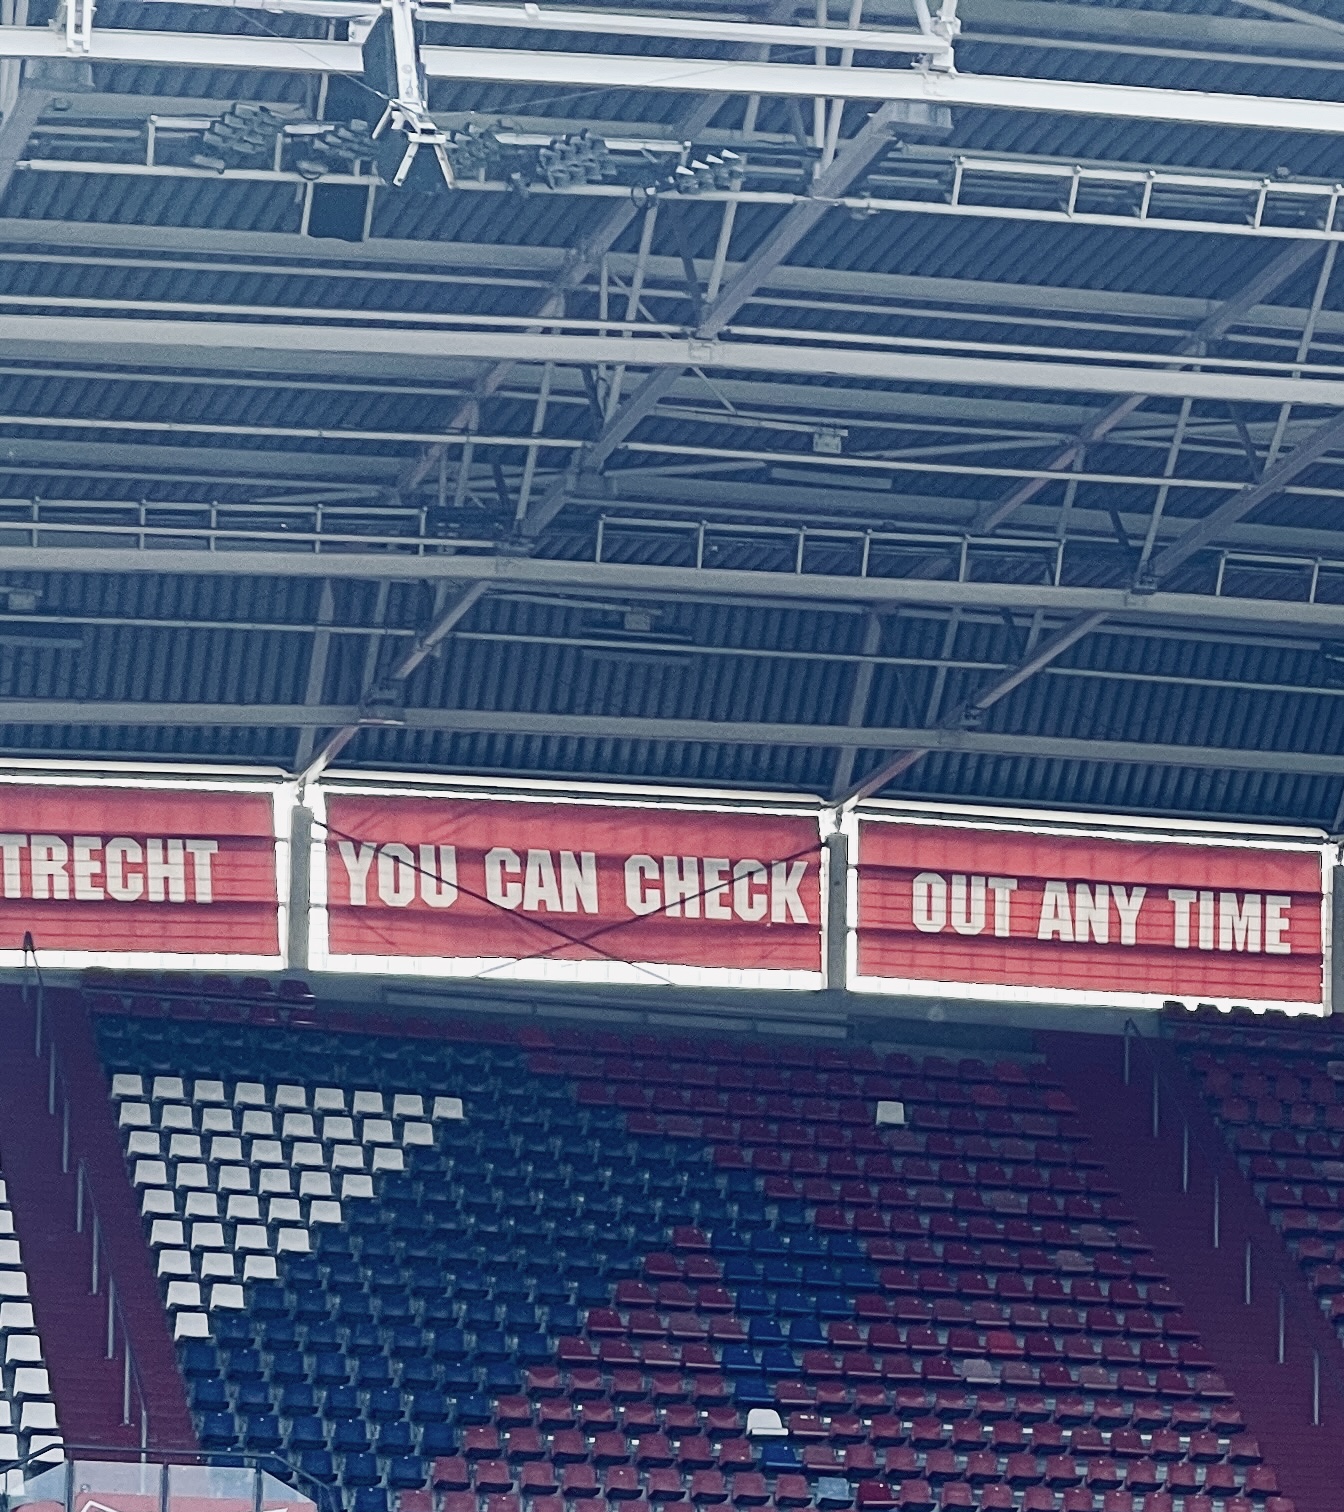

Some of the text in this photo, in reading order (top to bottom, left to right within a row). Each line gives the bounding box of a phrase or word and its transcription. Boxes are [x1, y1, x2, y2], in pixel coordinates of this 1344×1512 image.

[0, 834, 218, 903] TRECHT
[338, 841, 809, 924] YOU CAN CHECK
[913, 872, 1292, 954] OUT ANY TIME
